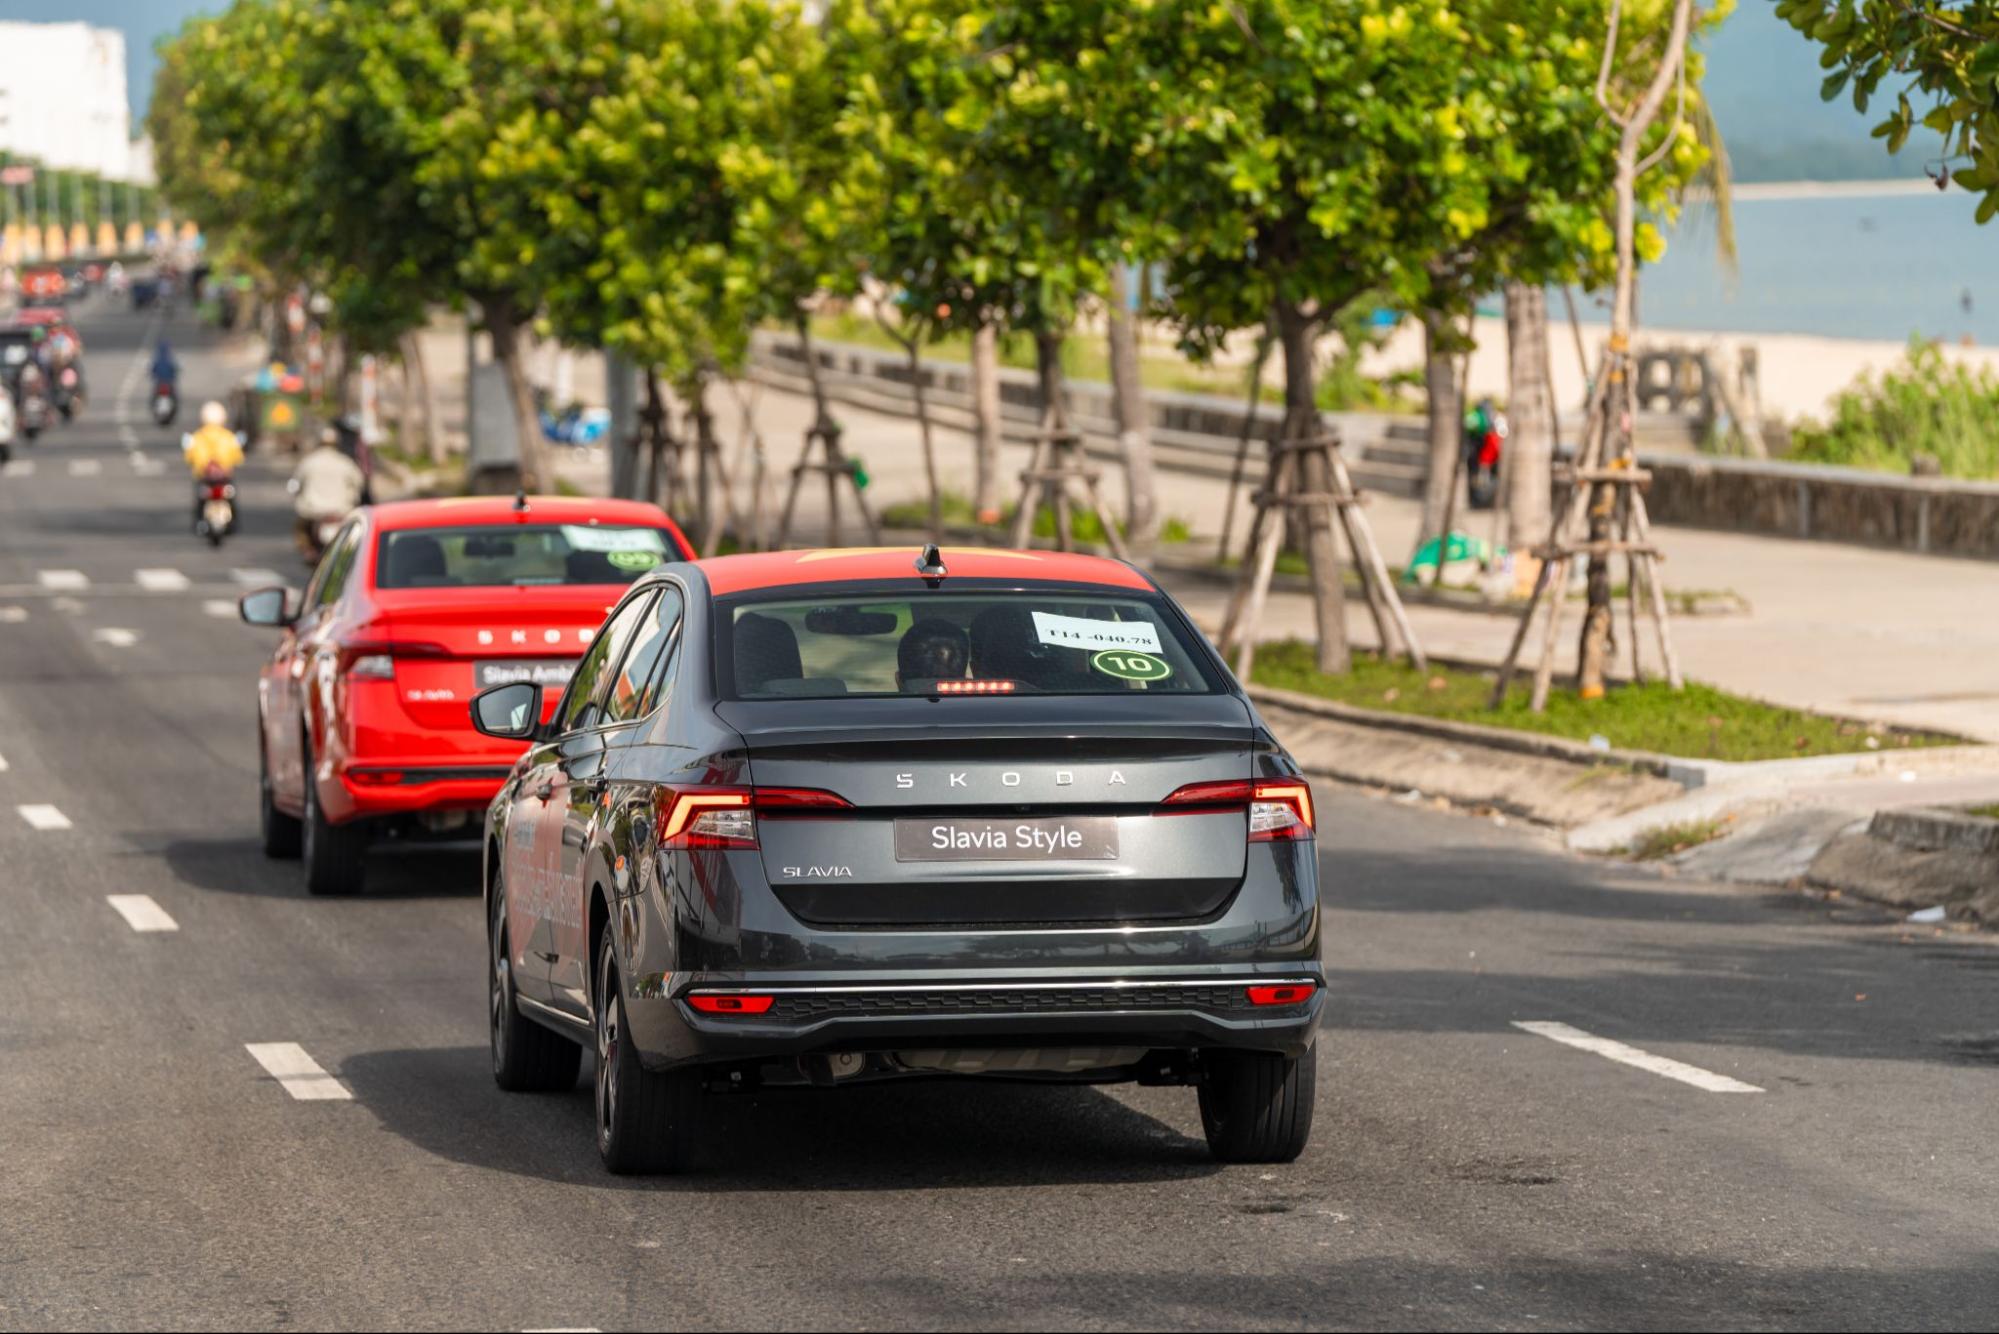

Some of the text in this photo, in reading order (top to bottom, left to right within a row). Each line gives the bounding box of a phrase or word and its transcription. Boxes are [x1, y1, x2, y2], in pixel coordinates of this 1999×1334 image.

[1108, 656, 1153, 672] 10
[931, 825, 1083, 854] Slavia Style
[783, 866, 853, 878] SLAVIA
